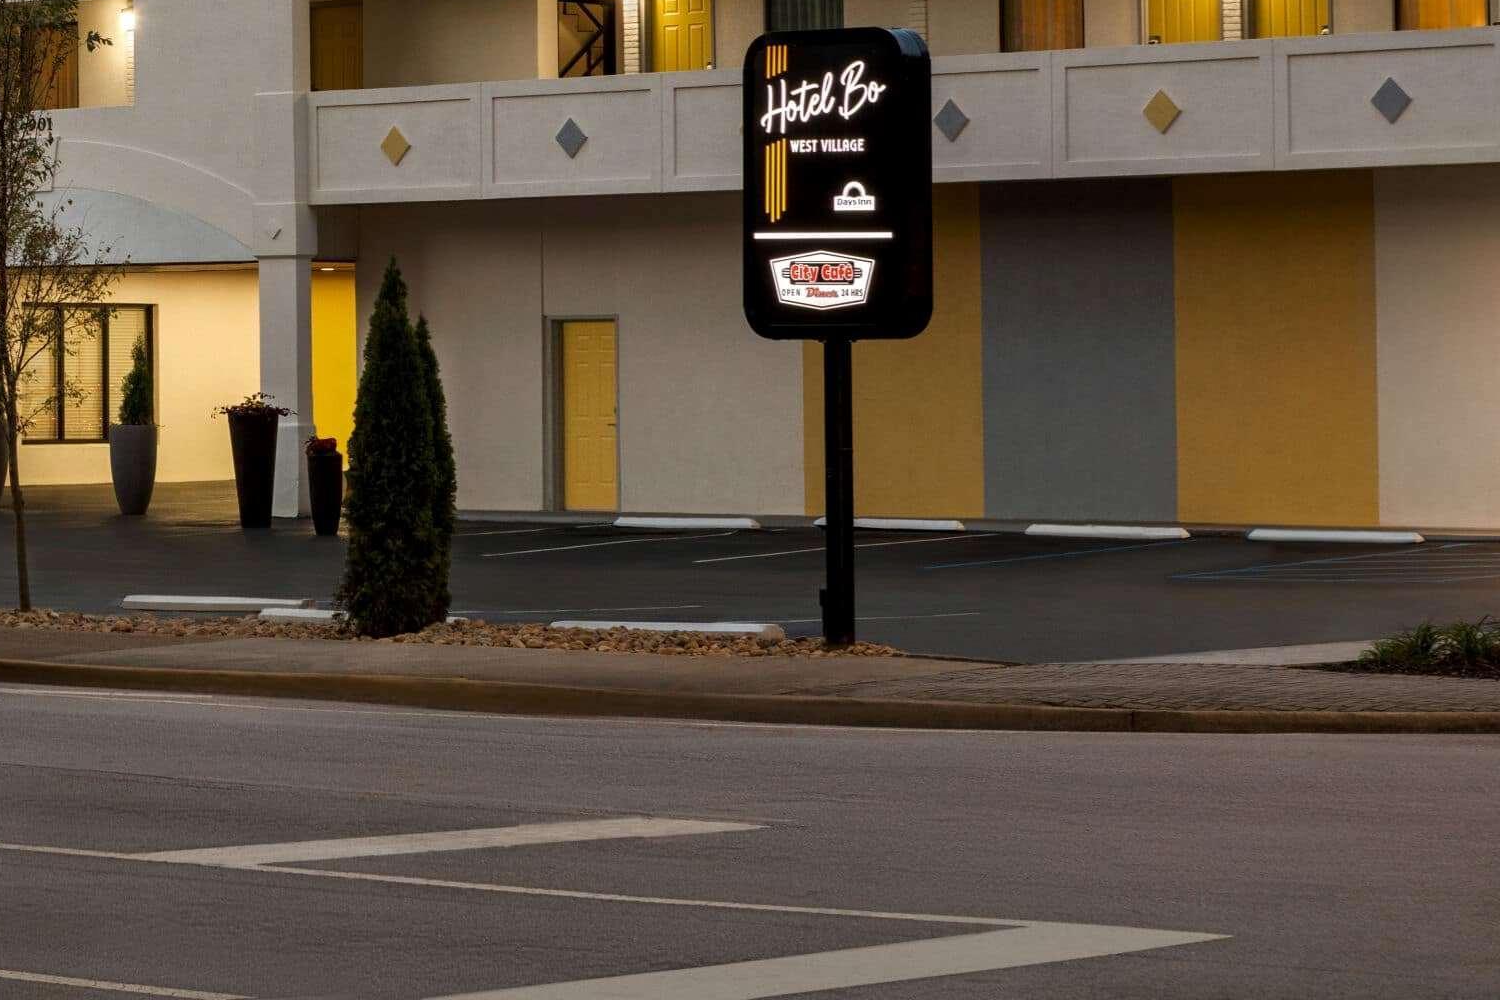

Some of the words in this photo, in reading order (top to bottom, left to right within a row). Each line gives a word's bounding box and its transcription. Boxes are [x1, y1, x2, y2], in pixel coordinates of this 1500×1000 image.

[760, 71, 836, 134] Hotel
[838, 60, 887, 120] Bo
[789, 140, 818, 153] WEST
[820, 138, 865, 152] VILLAGE
[836, 198, 857, 206] Days
[790, 263, 819, 283] City
[781, 288, 801, 297] OPEN
[841, 288, 849, 297] 24
[850, 288, 863, 297] HRS
